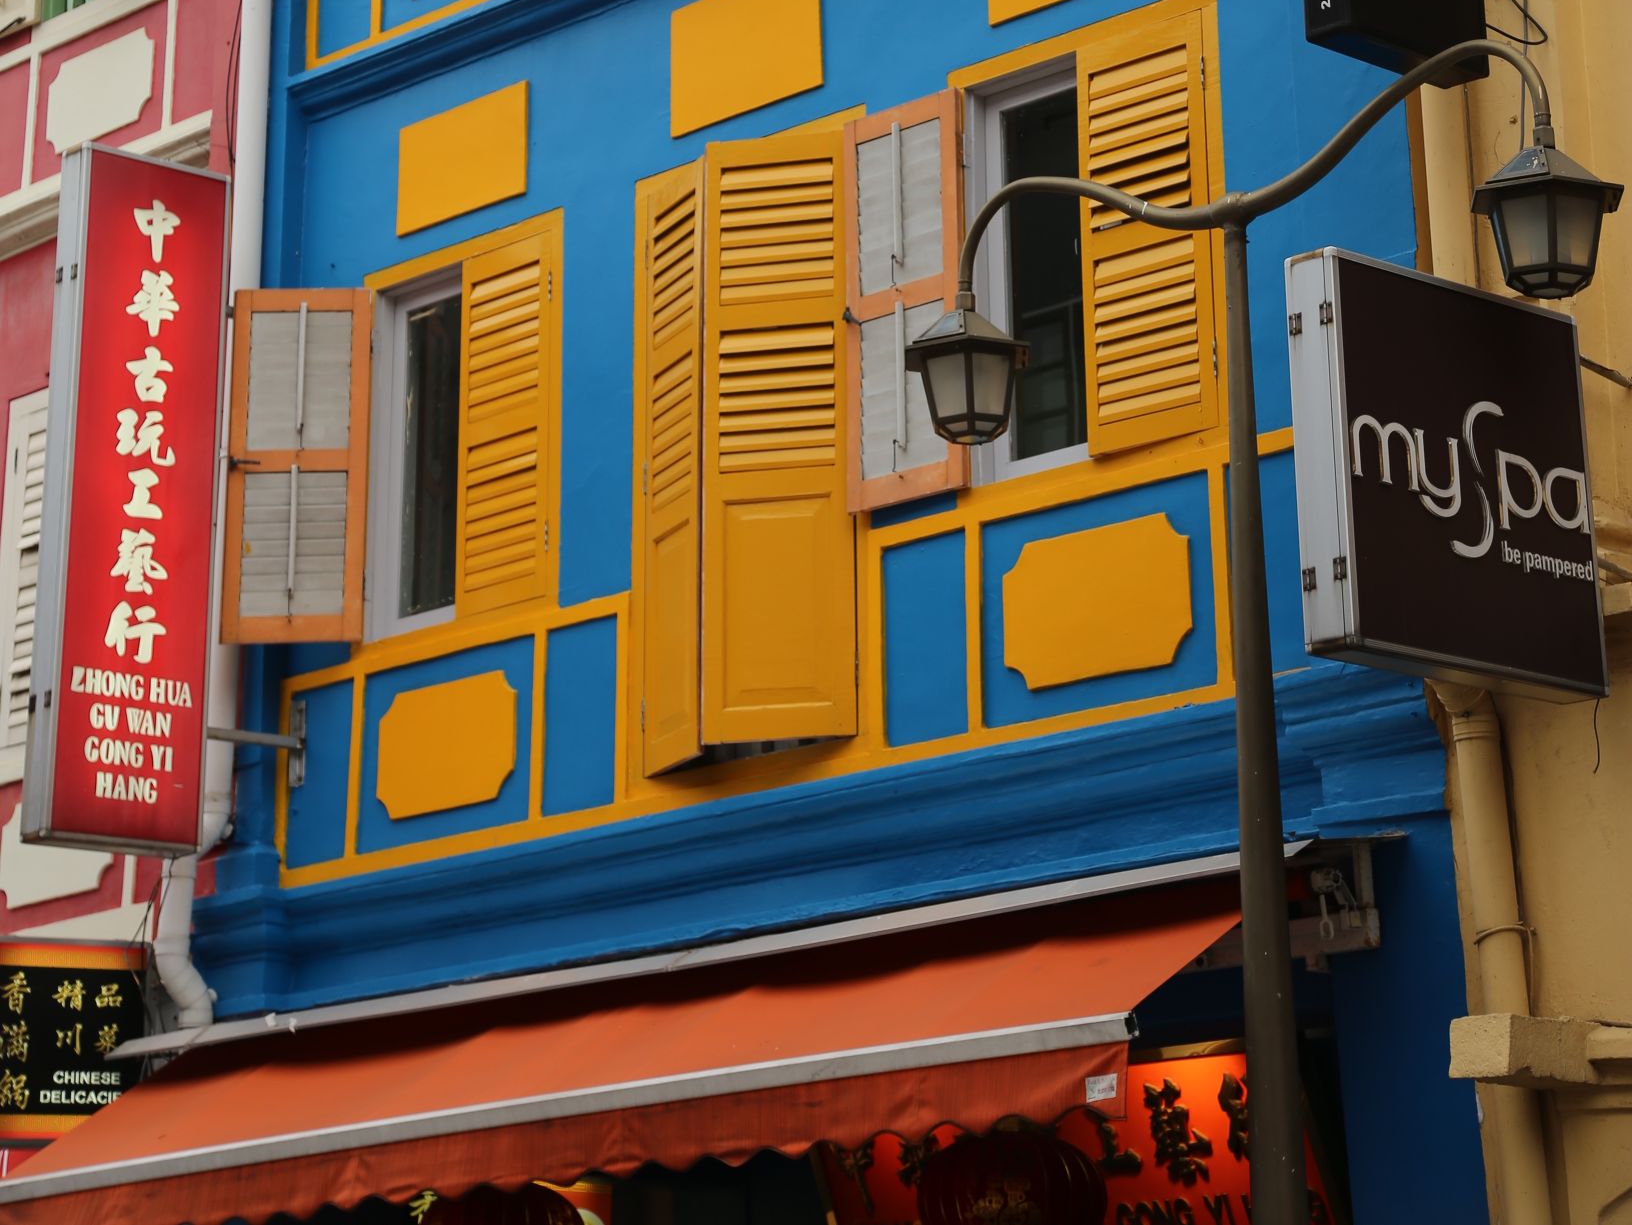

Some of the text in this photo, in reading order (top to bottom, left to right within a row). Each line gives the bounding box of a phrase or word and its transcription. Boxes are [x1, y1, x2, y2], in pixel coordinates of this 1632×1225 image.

[105, 200, 181, 664] 中華古玩工藝行
[1502, 540, 1595, 582] be pampered
[70, 666, 193, 709] ZHONG HUA
[89, 702, 172, 738] GU WAN
[84, 736, 173, 773] GONG YI
[95, 771, 158, 804] HANG
[52, 1070, 121, 1086] CHINESE
